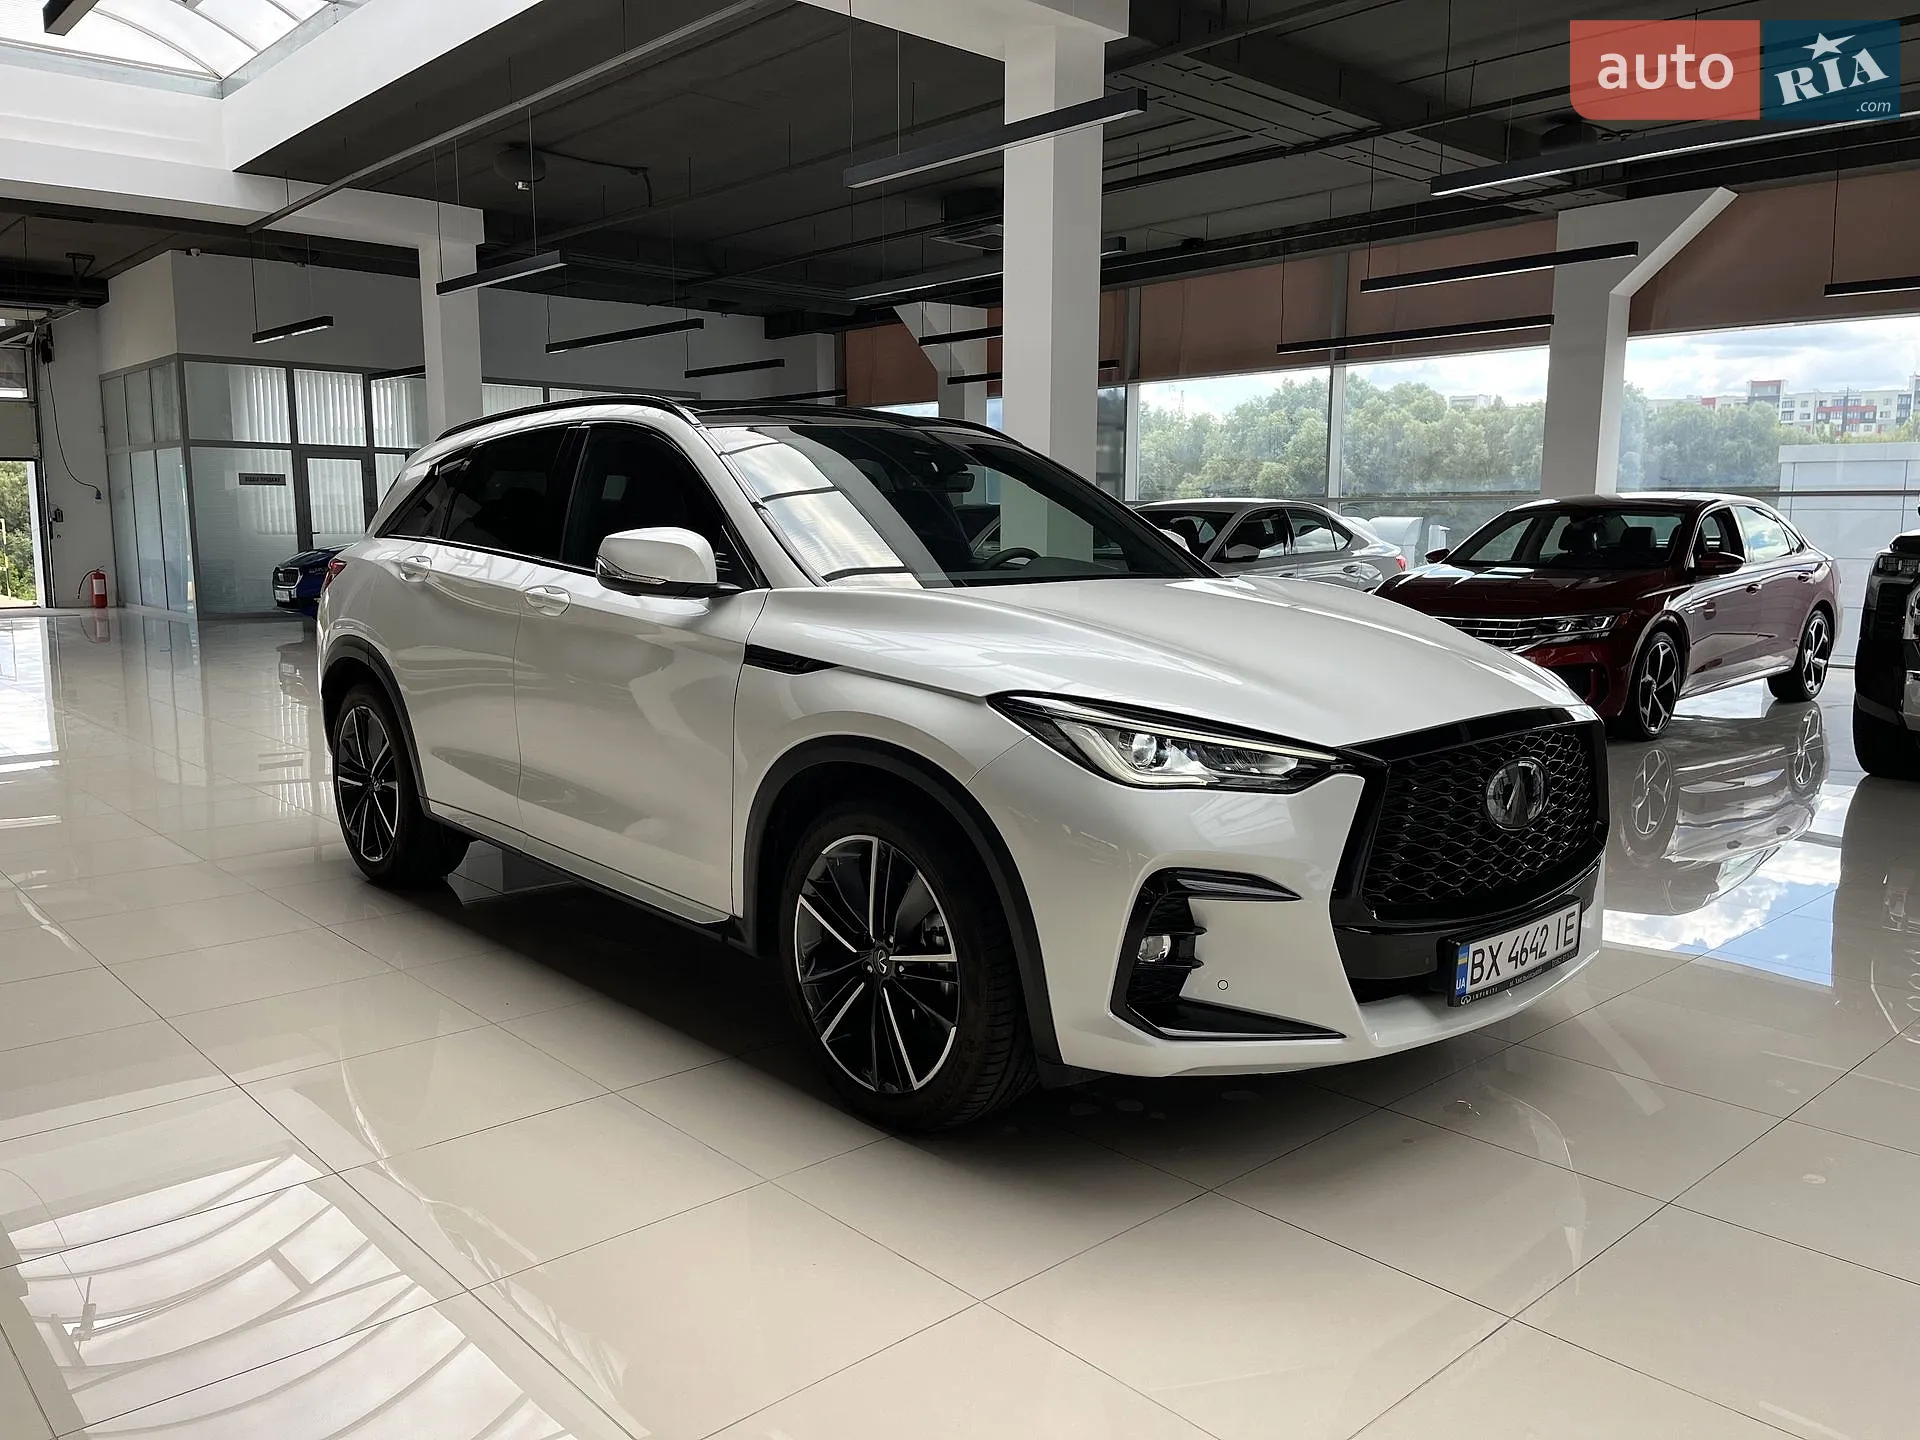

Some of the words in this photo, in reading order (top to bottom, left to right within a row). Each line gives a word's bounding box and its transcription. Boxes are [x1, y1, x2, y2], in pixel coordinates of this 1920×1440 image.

[1469, 941, 1504, 986] BX
[1507, 924, 1549, 970] 4642
[1555, 911, 1577, 951] IE
[1455, 977, 1467, 990] UA
